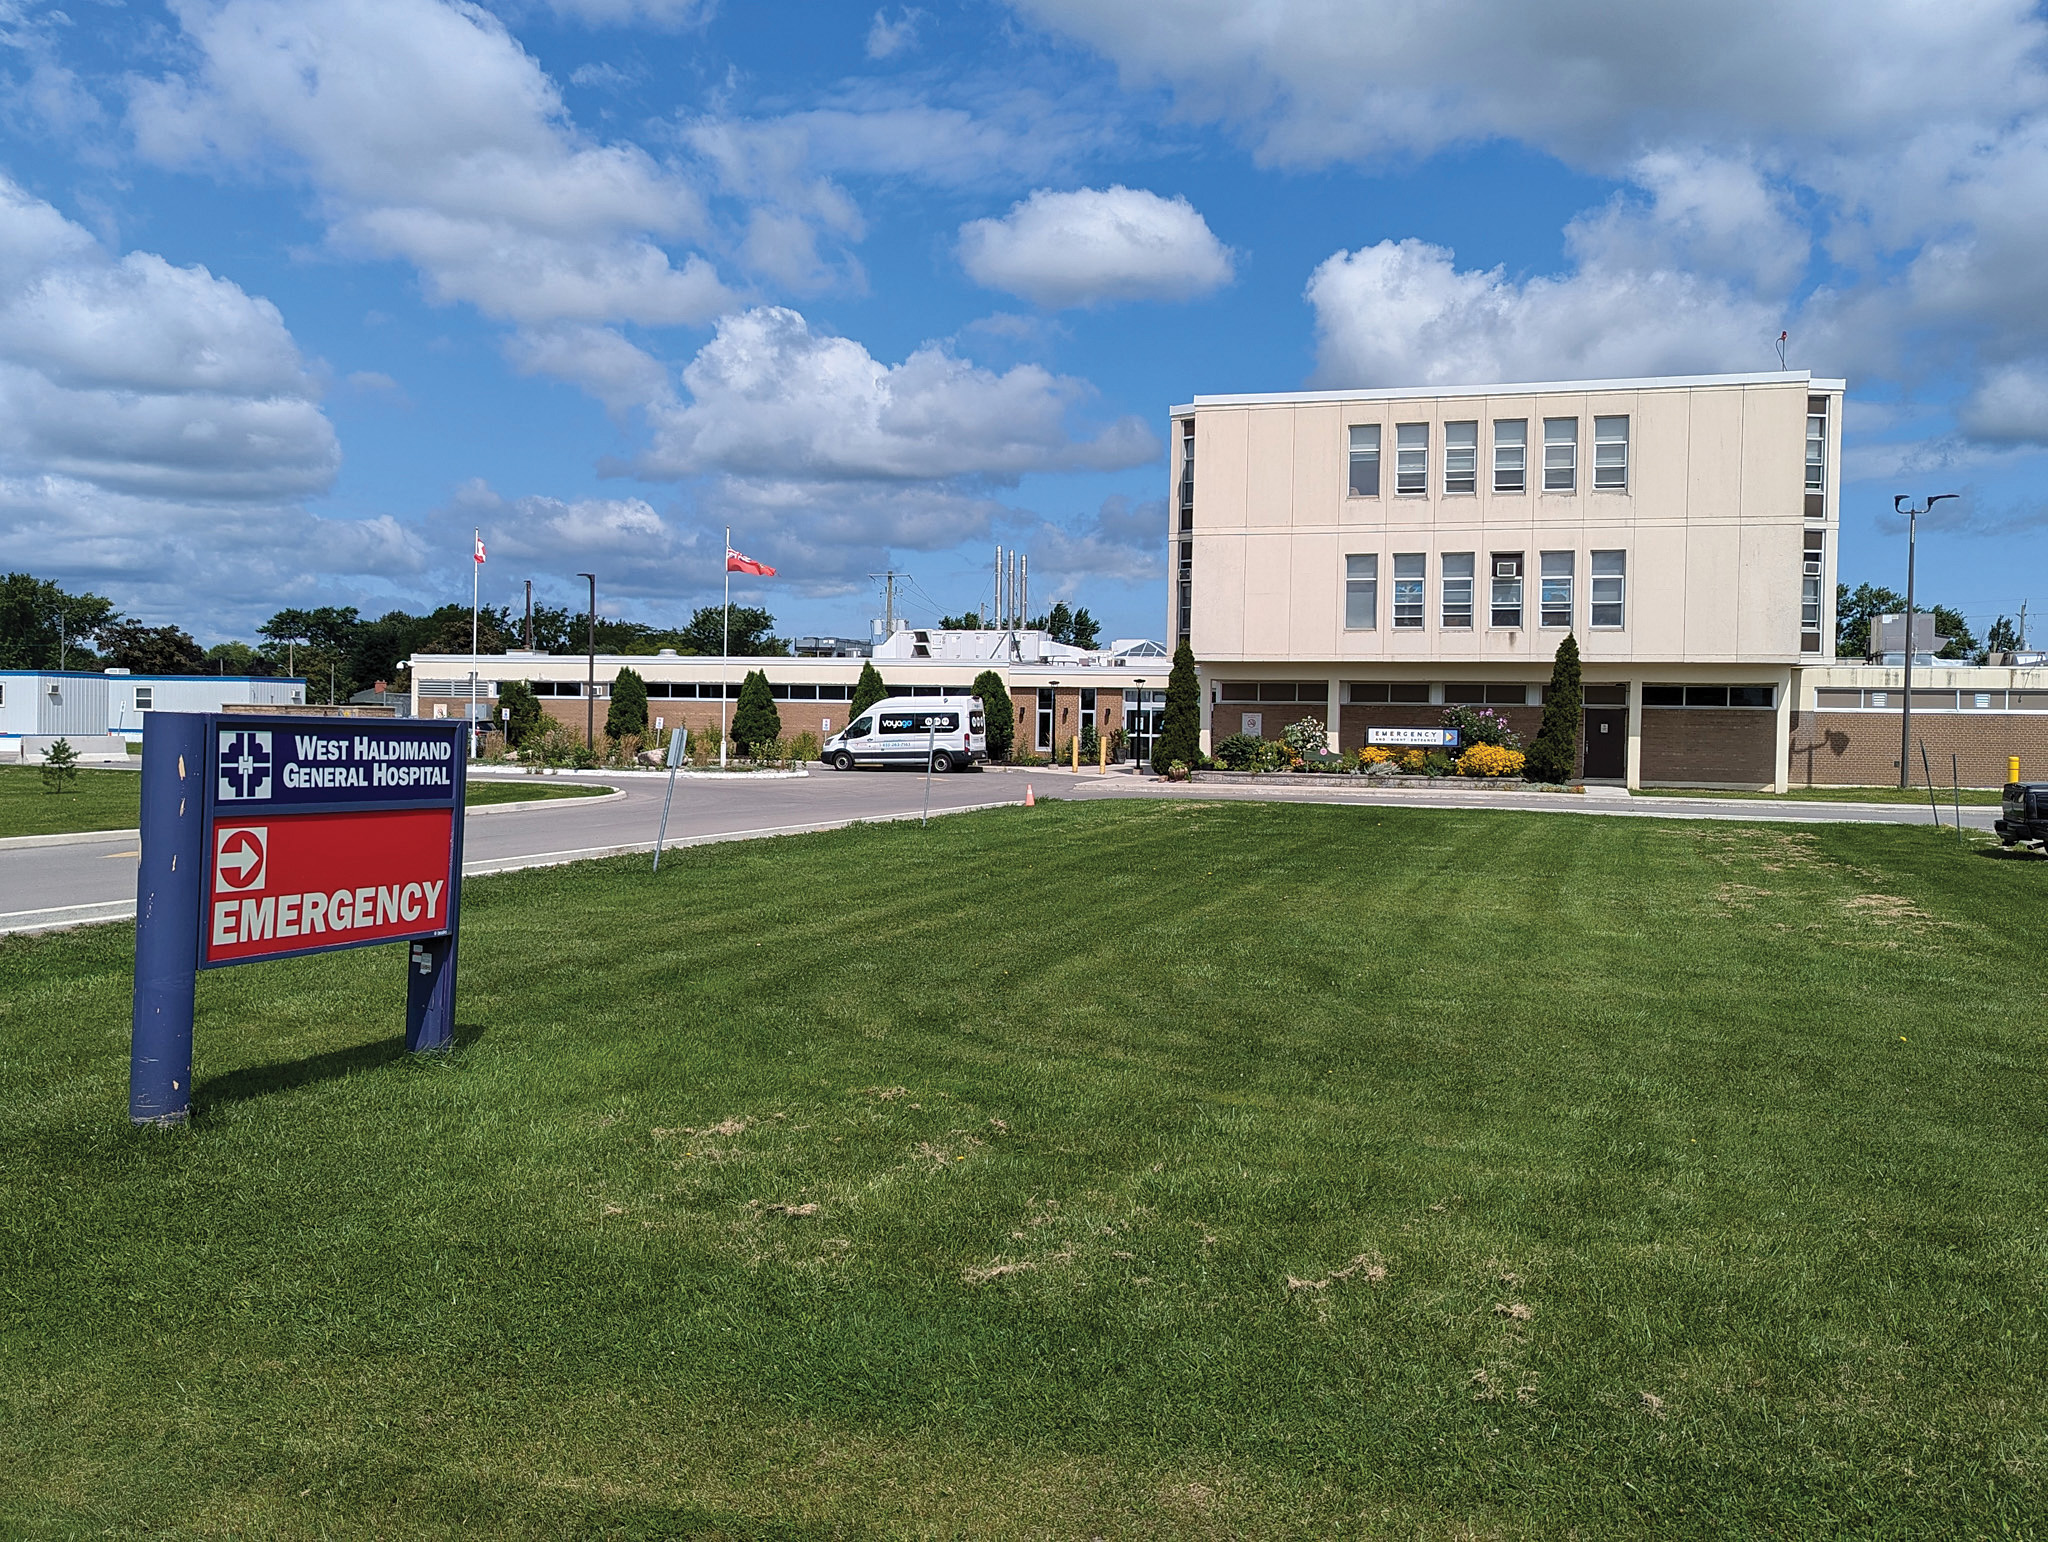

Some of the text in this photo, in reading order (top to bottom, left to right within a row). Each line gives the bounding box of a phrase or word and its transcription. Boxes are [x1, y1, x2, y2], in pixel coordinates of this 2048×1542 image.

[882, 720, 912, 729] voyago
[295, 735, 451, 761] WEST HALDIMAND
[283, 762, 451, 788] GENERAL HOSPITAL
[213, 879, 444, 945] EMERGENCY
